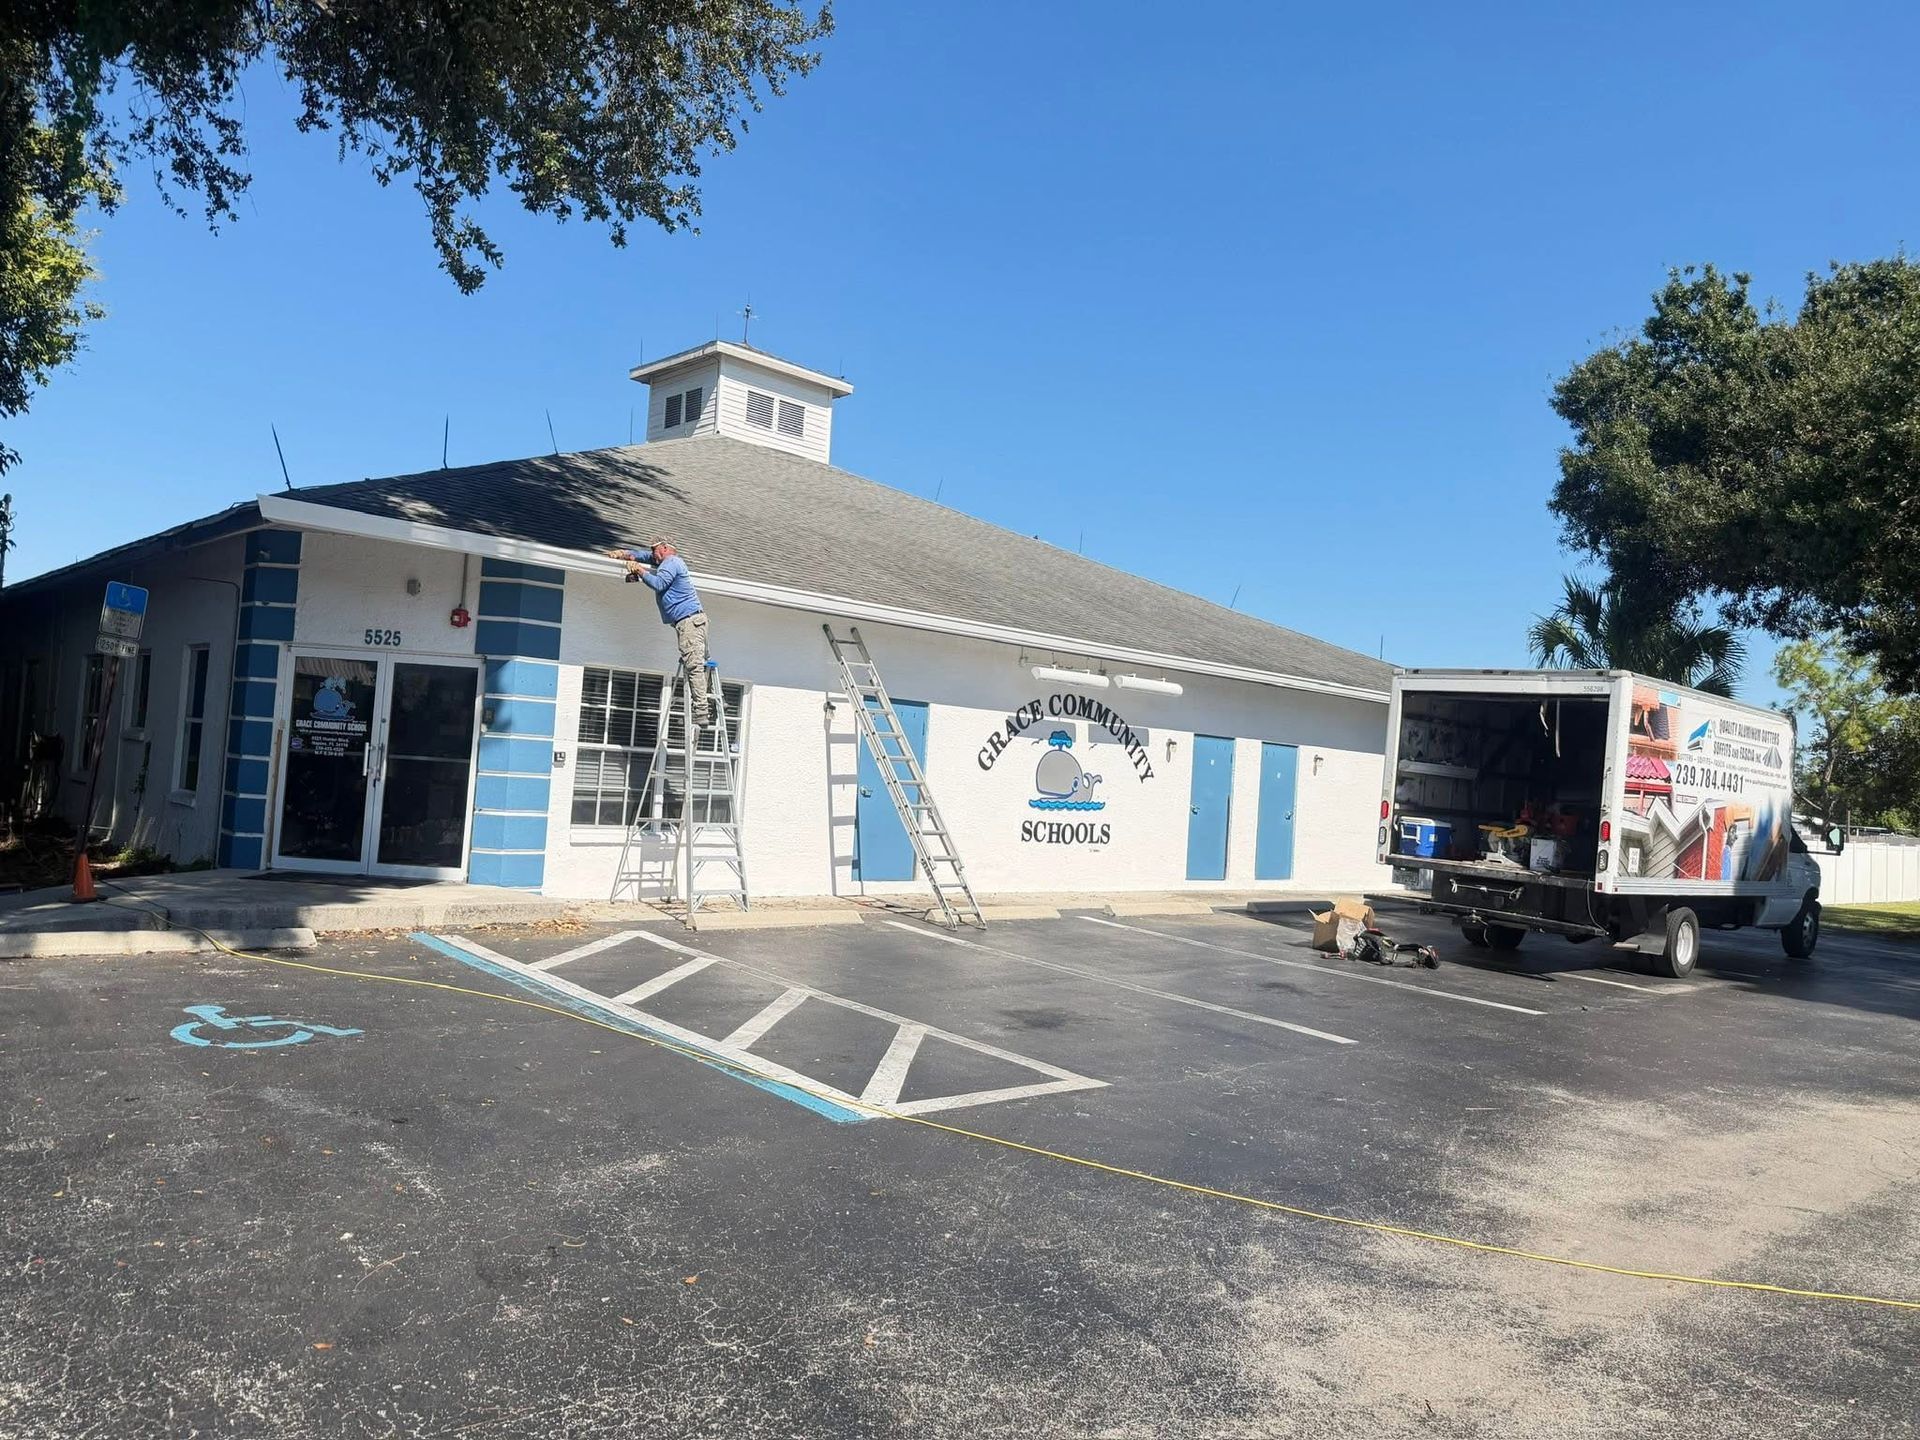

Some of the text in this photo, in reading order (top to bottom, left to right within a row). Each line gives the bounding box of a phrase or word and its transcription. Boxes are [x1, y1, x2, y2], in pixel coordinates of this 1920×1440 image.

[364, 629, 401, 646] 5525
[296, 720, 312, 728] GRACE
[313, 720, 347, 730] COMMUNITY
[347, 723, 367, 732] SCHOOL
[977, 693, 1155, 784] GRACE COMMUNITY
[1719, 719, 1780, 746] QUALITY ALUMINUM GUTTERS
[1713, 741, 1732, 758] SOFFITS
[1739, 746, 1755, 762] FASCIA
[1675, 763, 1744, 794] 239.784.4431
[1021, 820, 1111, 845] SCHOOLS
